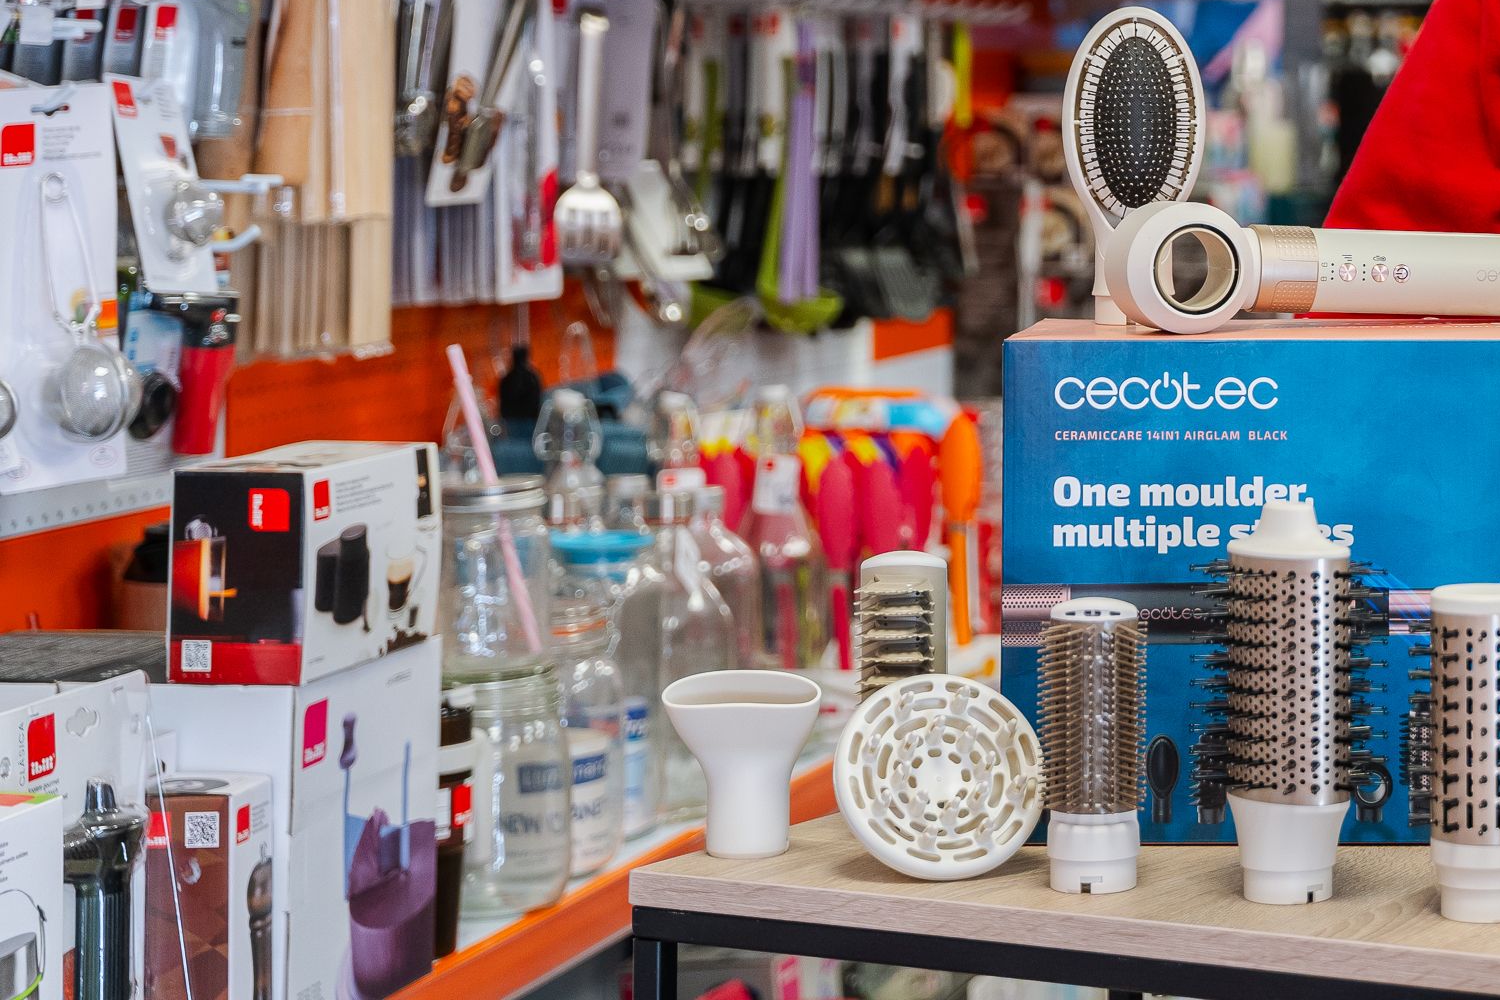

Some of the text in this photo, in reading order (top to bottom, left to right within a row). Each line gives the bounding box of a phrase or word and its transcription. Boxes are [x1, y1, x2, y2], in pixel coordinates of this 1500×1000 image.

[1054, 371, 1279, 410] cecotec
[1055, 430, 1288, 441] CERAMICCARE 14IN1 AIRGLAM BLACK
[1053, 476, 1314, 507] One moulder,
[1053, 515, 1220, 554] multiple
